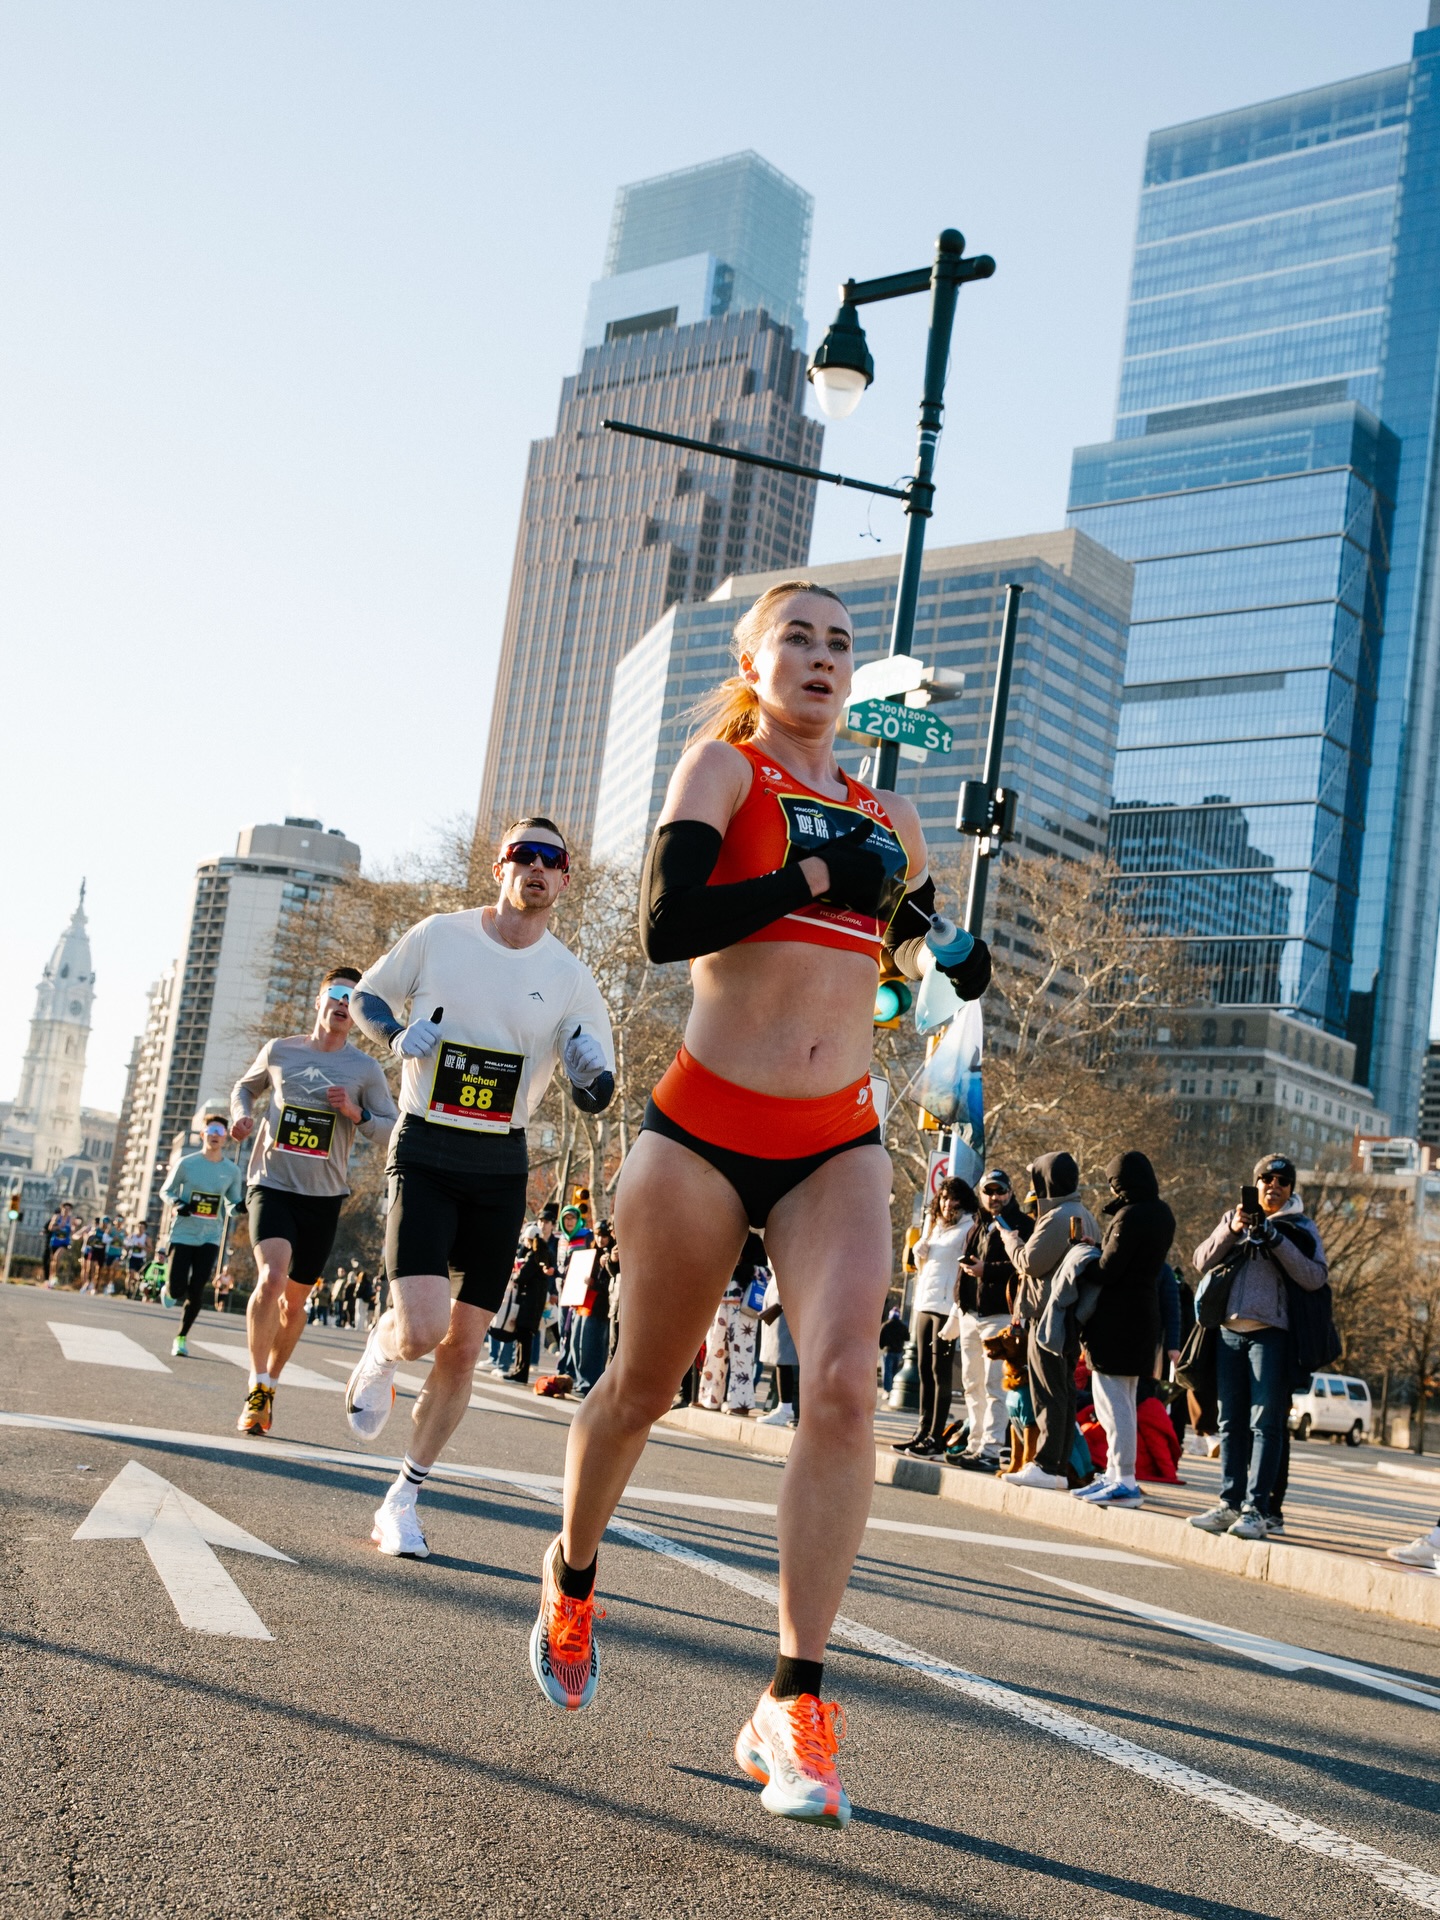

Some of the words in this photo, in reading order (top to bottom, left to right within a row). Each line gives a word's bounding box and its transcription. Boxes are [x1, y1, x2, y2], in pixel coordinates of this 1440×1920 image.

[879, 703, 897, 714] 300
[897, 706, 907, 719] N
[908, 711, 926, 722] 200
[866, 712, 916, 739] 20th
[924, 727, 952, 753] St
[793, 806, 819, 814] saucony
[820, 910, 836, 919] RED
[836, 914, 862, 927] CORRAL
[462, 1073, 497, 1087] Michael
[459, 1085, 493, 1110] 88
[289, 1131, 319, 1149] 570
